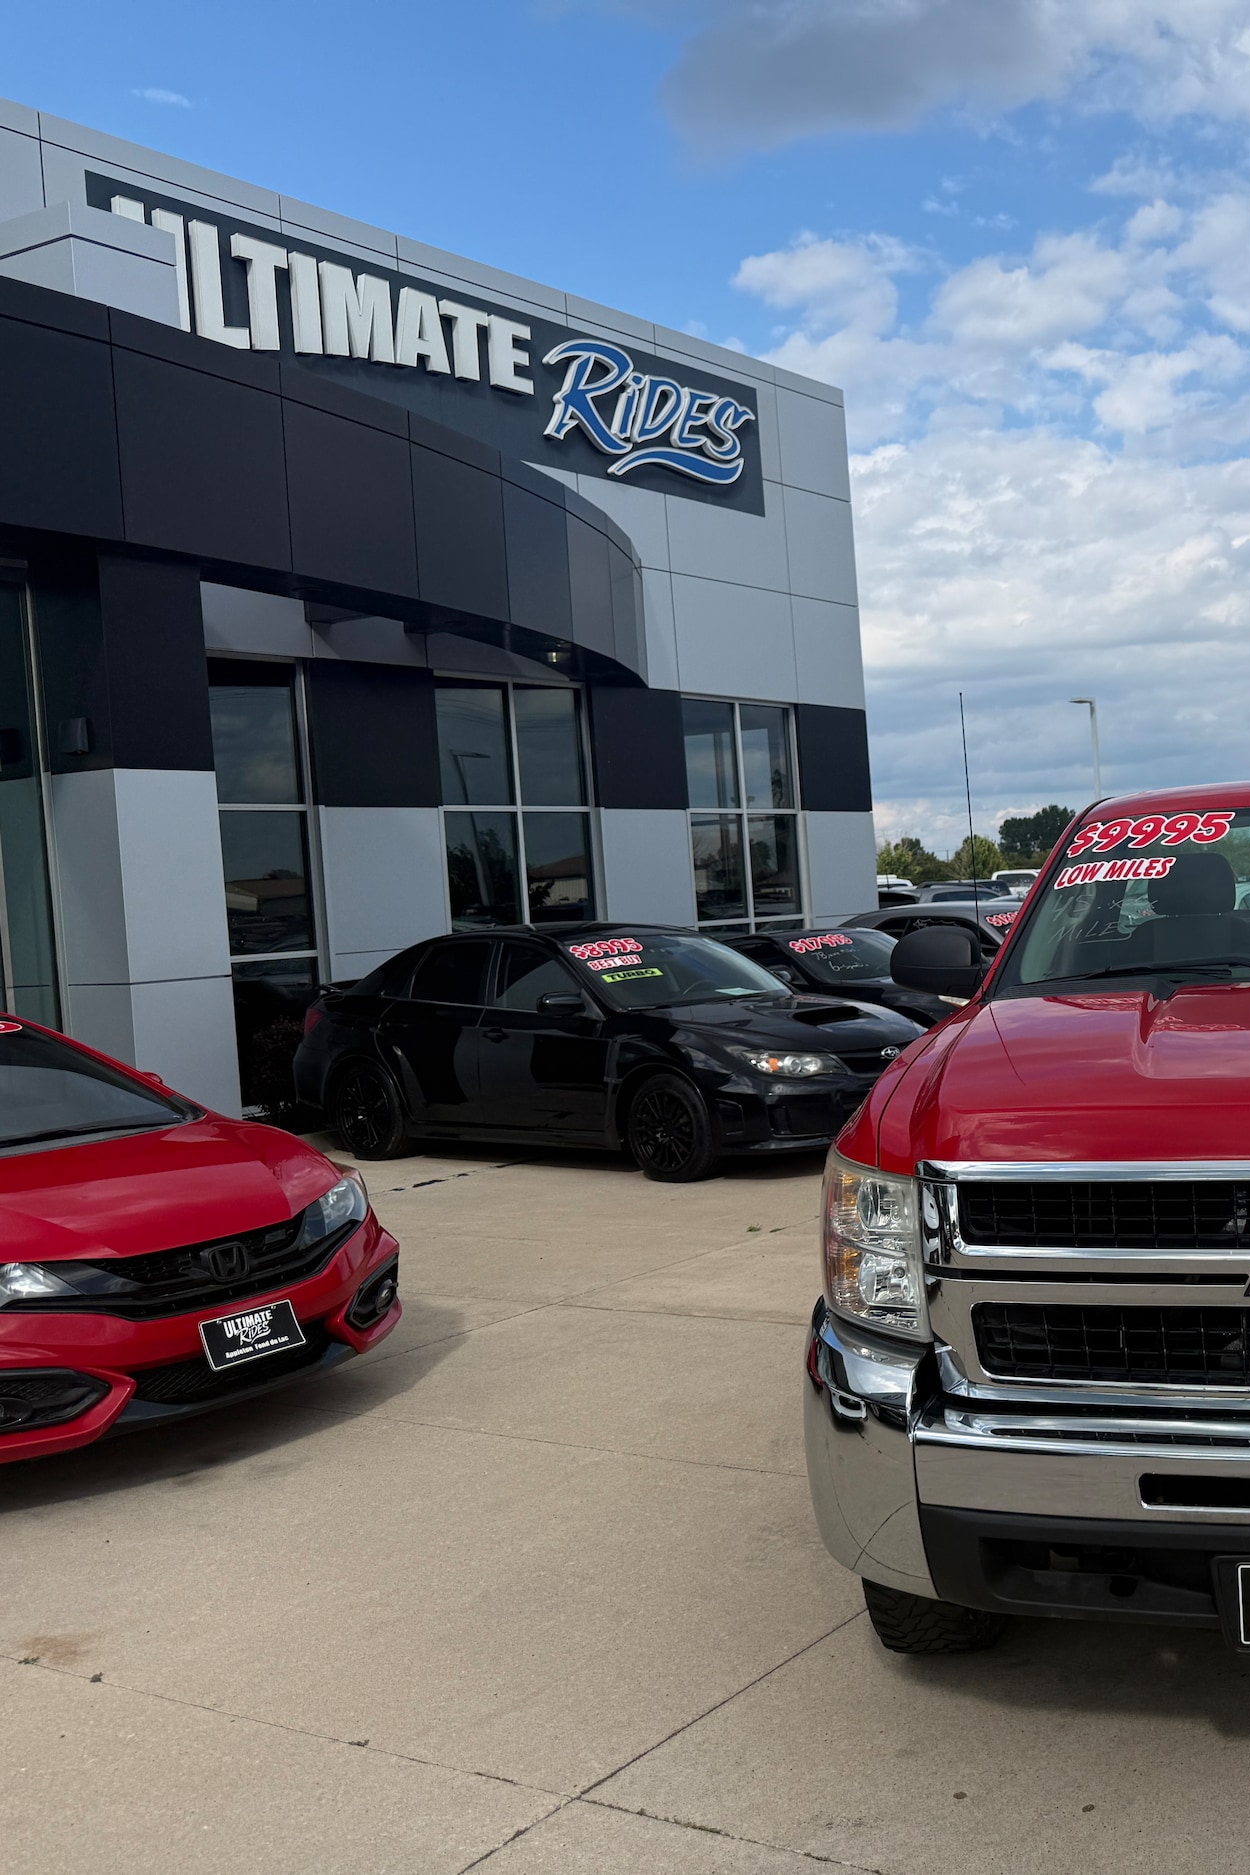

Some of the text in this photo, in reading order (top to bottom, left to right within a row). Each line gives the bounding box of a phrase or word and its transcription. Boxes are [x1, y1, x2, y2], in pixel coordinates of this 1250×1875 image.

[1067, 812, 1236, 858] $9995
[1055, 857, 1176, 889] LOW MILES
[569, 938, 643, 959] $8995
[789, 934, 853, 954] $17995
[587, 954, 642, 971] BEST BUY
[605, 969, 656, 980] TURBO
[223, 1309, 273, 1338] ULTIMATE
[225, 1346, 254, 1359] Appleton
[254, 1340, 271, 1350] Fond
[278, 1335, 289, 1343] Lac
